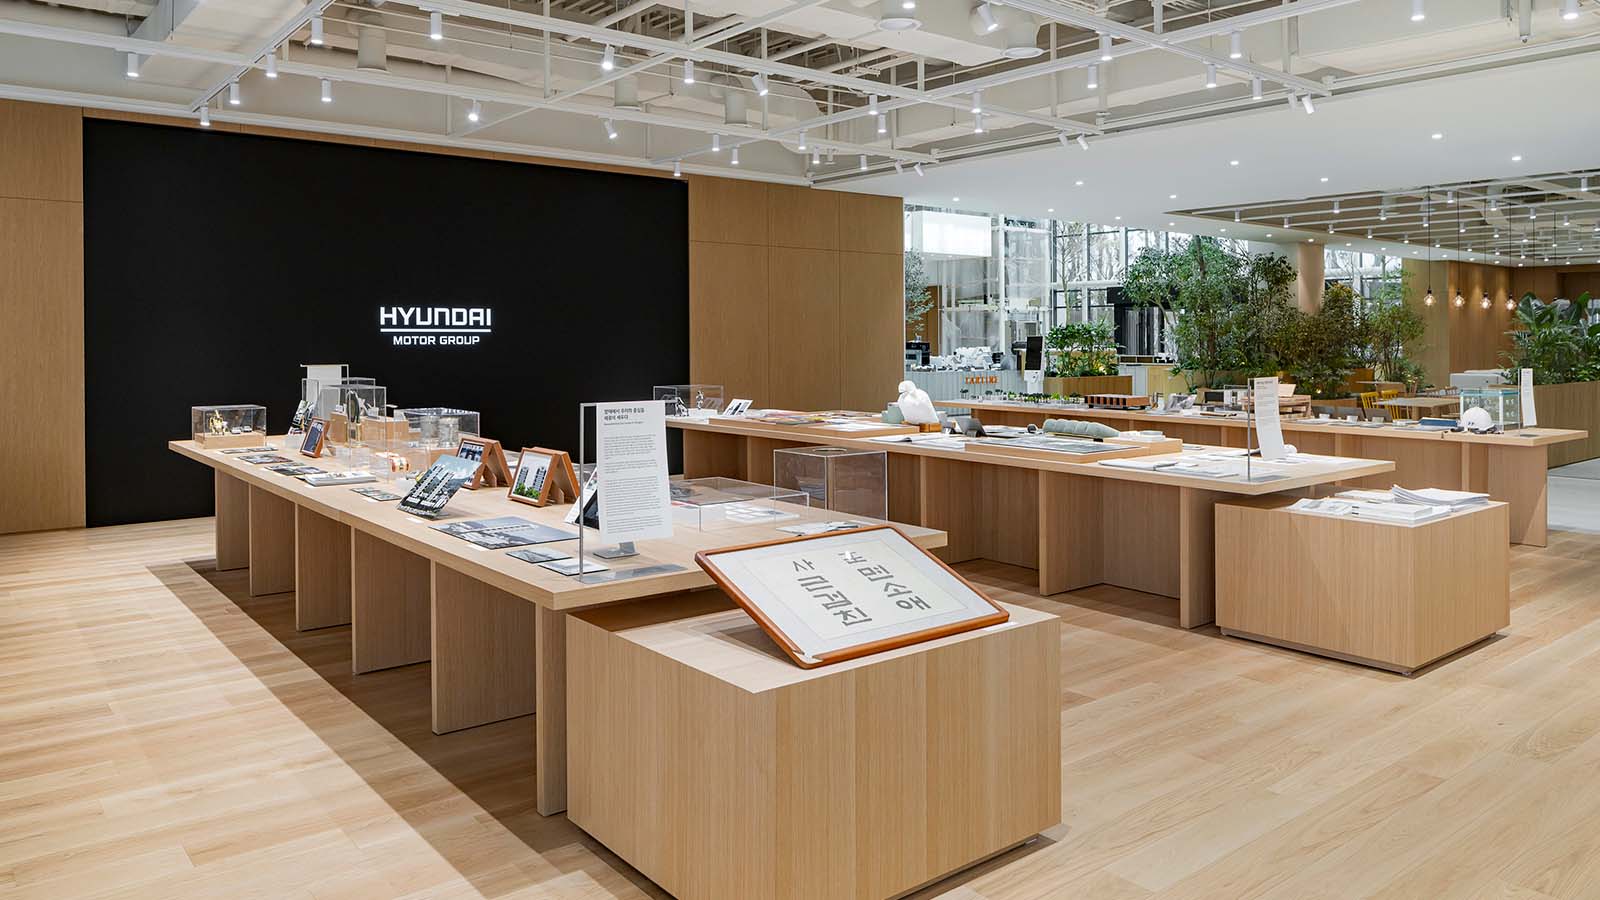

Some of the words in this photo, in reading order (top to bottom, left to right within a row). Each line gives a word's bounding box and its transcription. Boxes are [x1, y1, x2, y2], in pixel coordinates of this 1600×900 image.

[380, 306, 491, 326] HYUNDAI
[393, 335, 436, 345] MOTOR
[439, 335, 480, 345] GROUP
